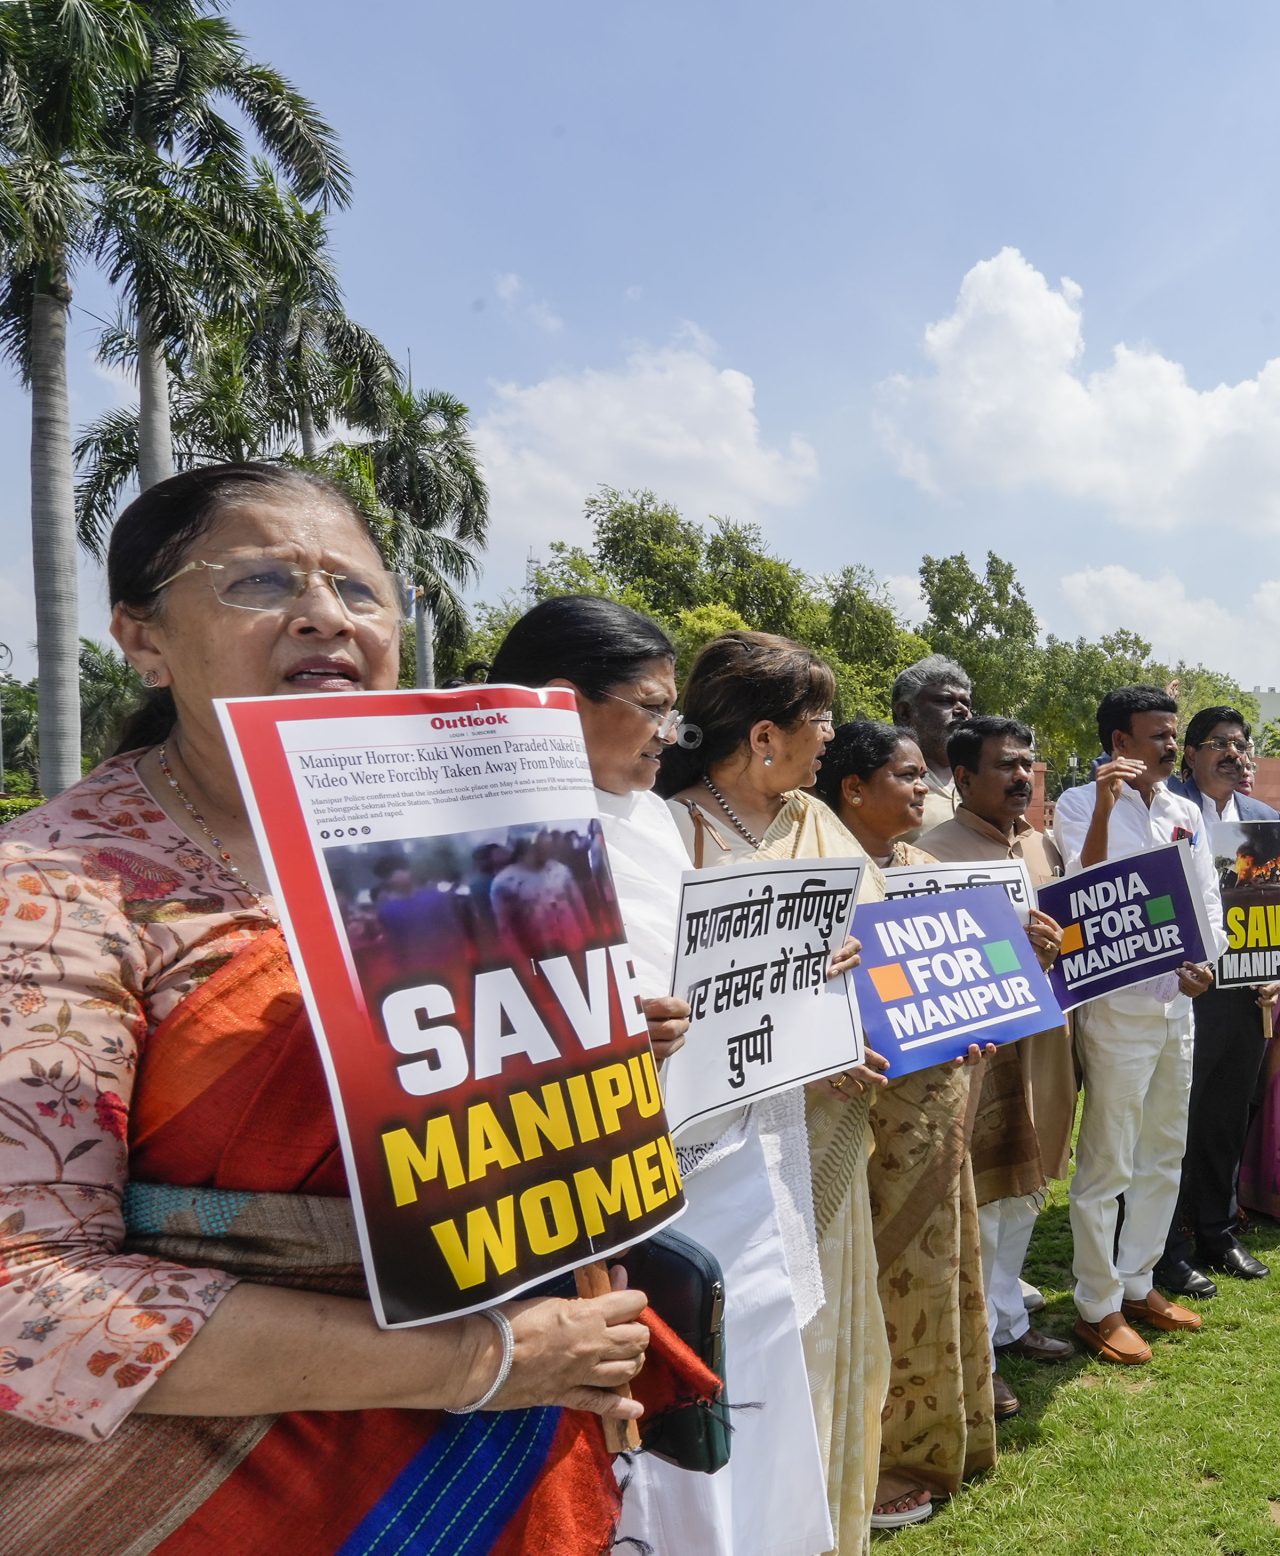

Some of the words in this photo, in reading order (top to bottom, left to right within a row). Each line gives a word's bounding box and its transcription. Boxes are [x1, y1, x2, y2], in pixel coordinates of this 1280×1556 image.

[431, 712, 509, 730] Outlook
[299, 753, 362, 770] Manipur
[365, 751, 415, 765] Horror:
[416, 747, 449, 761] Kuki
[450, 745, 501, 759] Women
[504, 738, 548, 754] Paraded
[549, 739, 574, 752] Naked
[304, 774, 348, 789] Video
[350, 771, 385, 785] Were
[387, 766, 438, 784] Forcibly
[441, 764, 481, 779] Taken
[484, 761, 517, 775] Away
[520, 757, 548, 770] From
[549, 756, 574, 769] Police
[311, 797, 342, 806] Manipur
[344, 795, 365, 803] Police
[366, 792, 400, 801] confirmed
[401, 791, 414, 799] that
[426, 786, 453, 796] incident
[454, 785, 470, 793] took
[471, 784, 489, 793] place
[499, 781, 514, 789] May
[314, 807, 327, 815] the
[387, 800, 406, 808] Police
[460, 792, 483, 801] district
[485, 790, 500, 798] after
[316, 814, 346, 825] paraded
[348, 812, 369, 820] naked
[684, 884, 774, 956] प्रधानमंत्री
[776, 878, 853, 939] मणिपुर
[1069, 871, 1150, 919] INDIA
[874, 908, 986, 957] INDIA
[1083, 904, 1145, 946] FOR
[714, 959, 768, 1014] संसद
[769, 946, 793, 995] में
[792, 939, 831, 996] तोड़ो
[906, 947, 990, 994] FOR
[1061, 924, 1183, 982] MANIPUR
[382, 944, 649, 1096] SAVE
[885, 976, 1037, 1039] MANIPUR
[727, 1014, 774, 1088] चुप्पी
[382, 1051, 664, 1207] MANIPU
[430, 1131, 683, 1290] WOMEN
